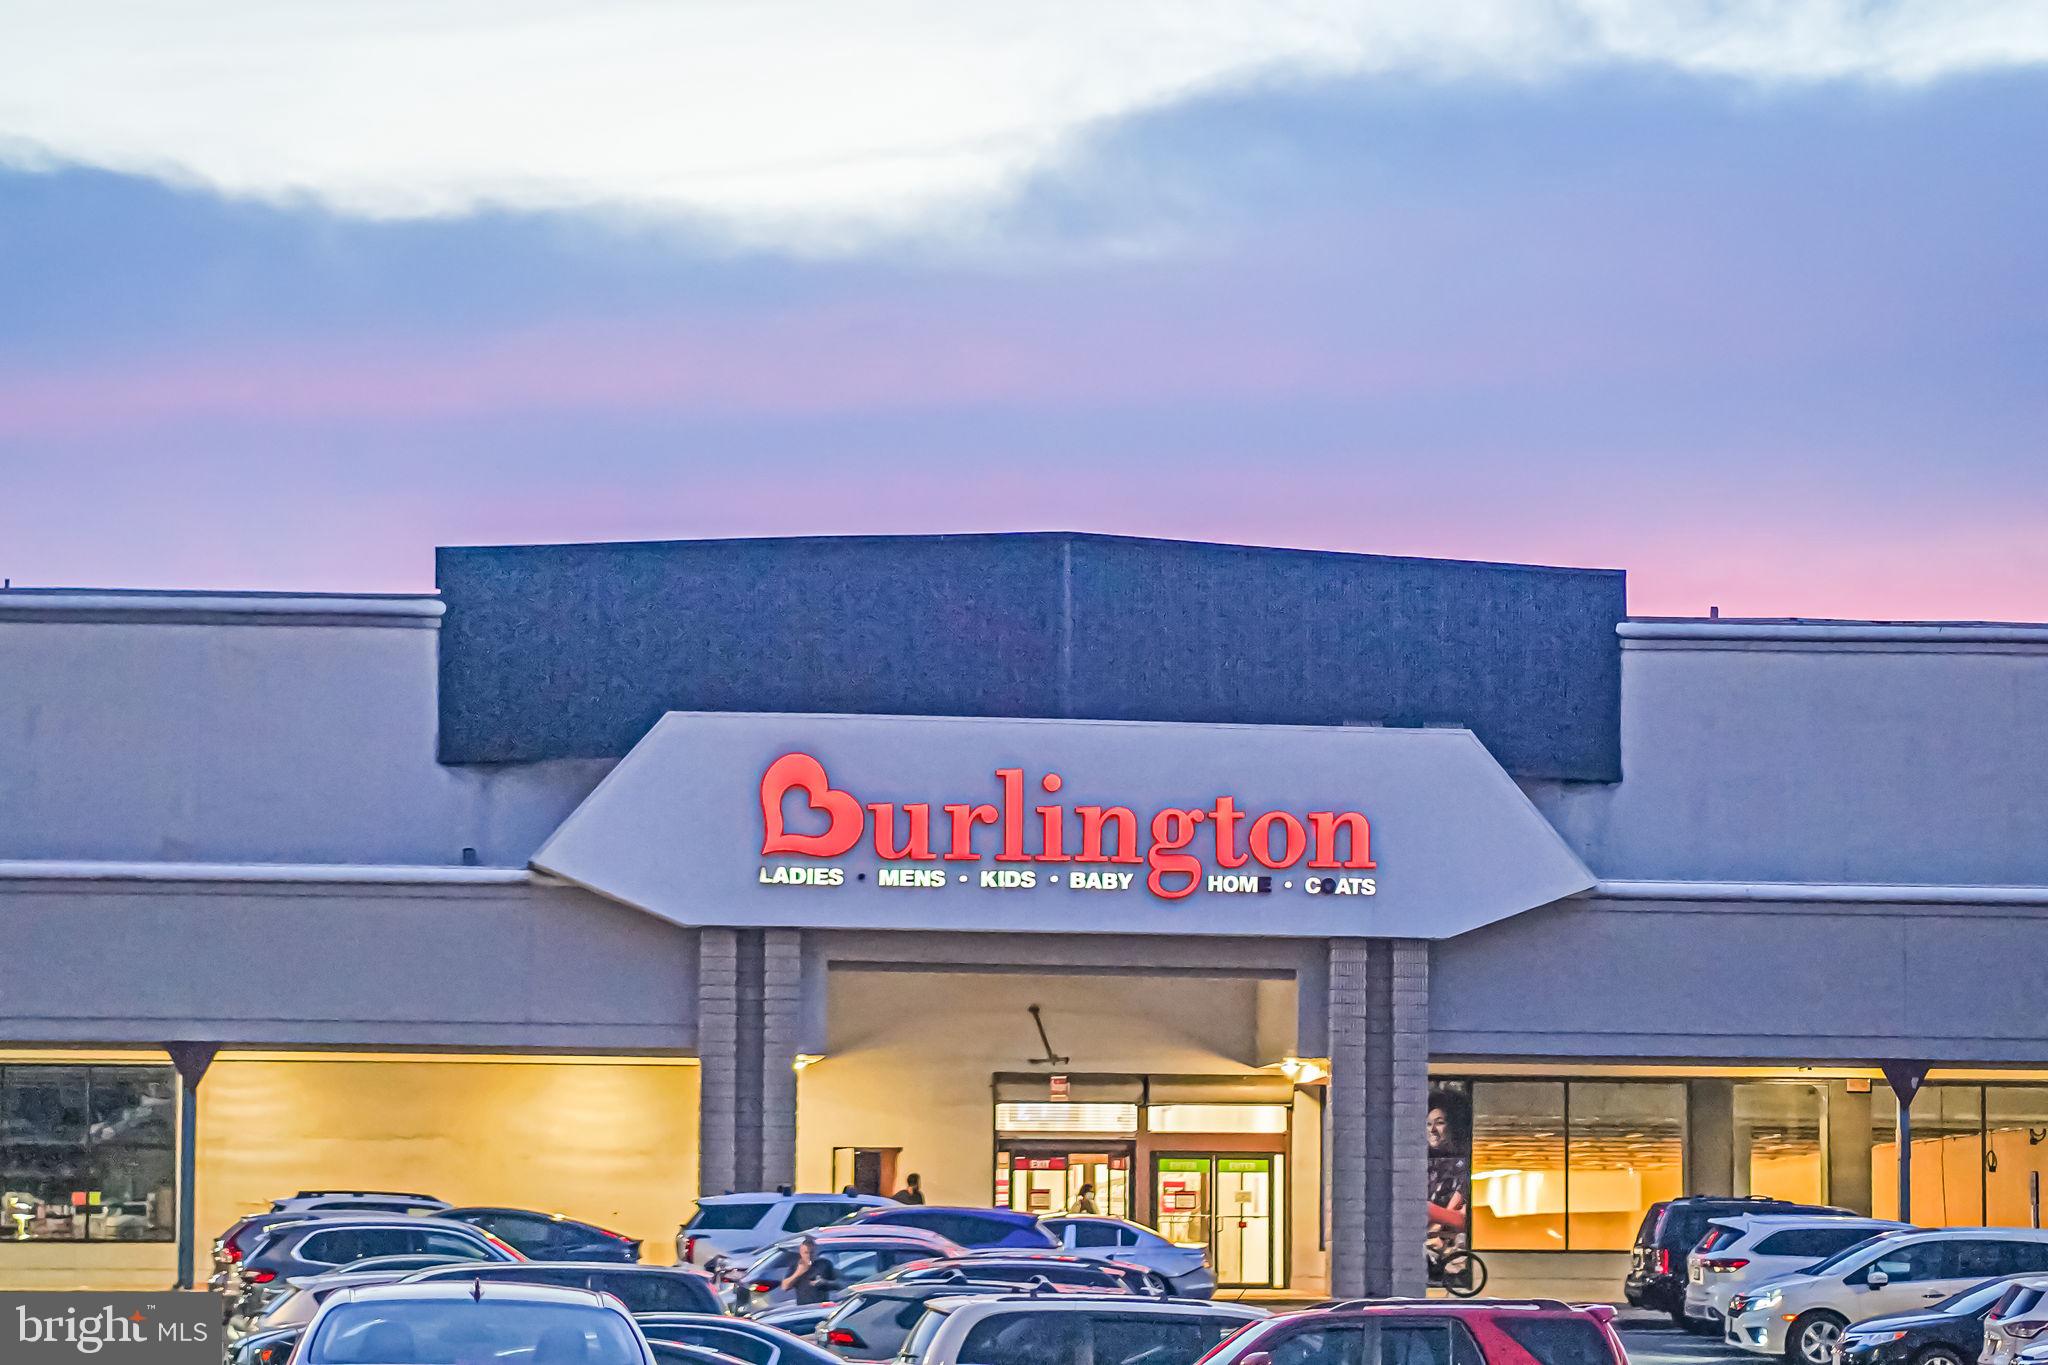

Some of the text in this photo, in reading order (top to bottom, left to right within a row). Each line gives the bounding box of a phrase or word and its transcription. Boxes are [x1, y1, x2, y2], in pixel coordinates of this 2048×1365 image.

[761, 752, 1377, 900] Burlington
[759, 866, 1377, 896] LADIES MENS KIDS BABY HOME COATS
